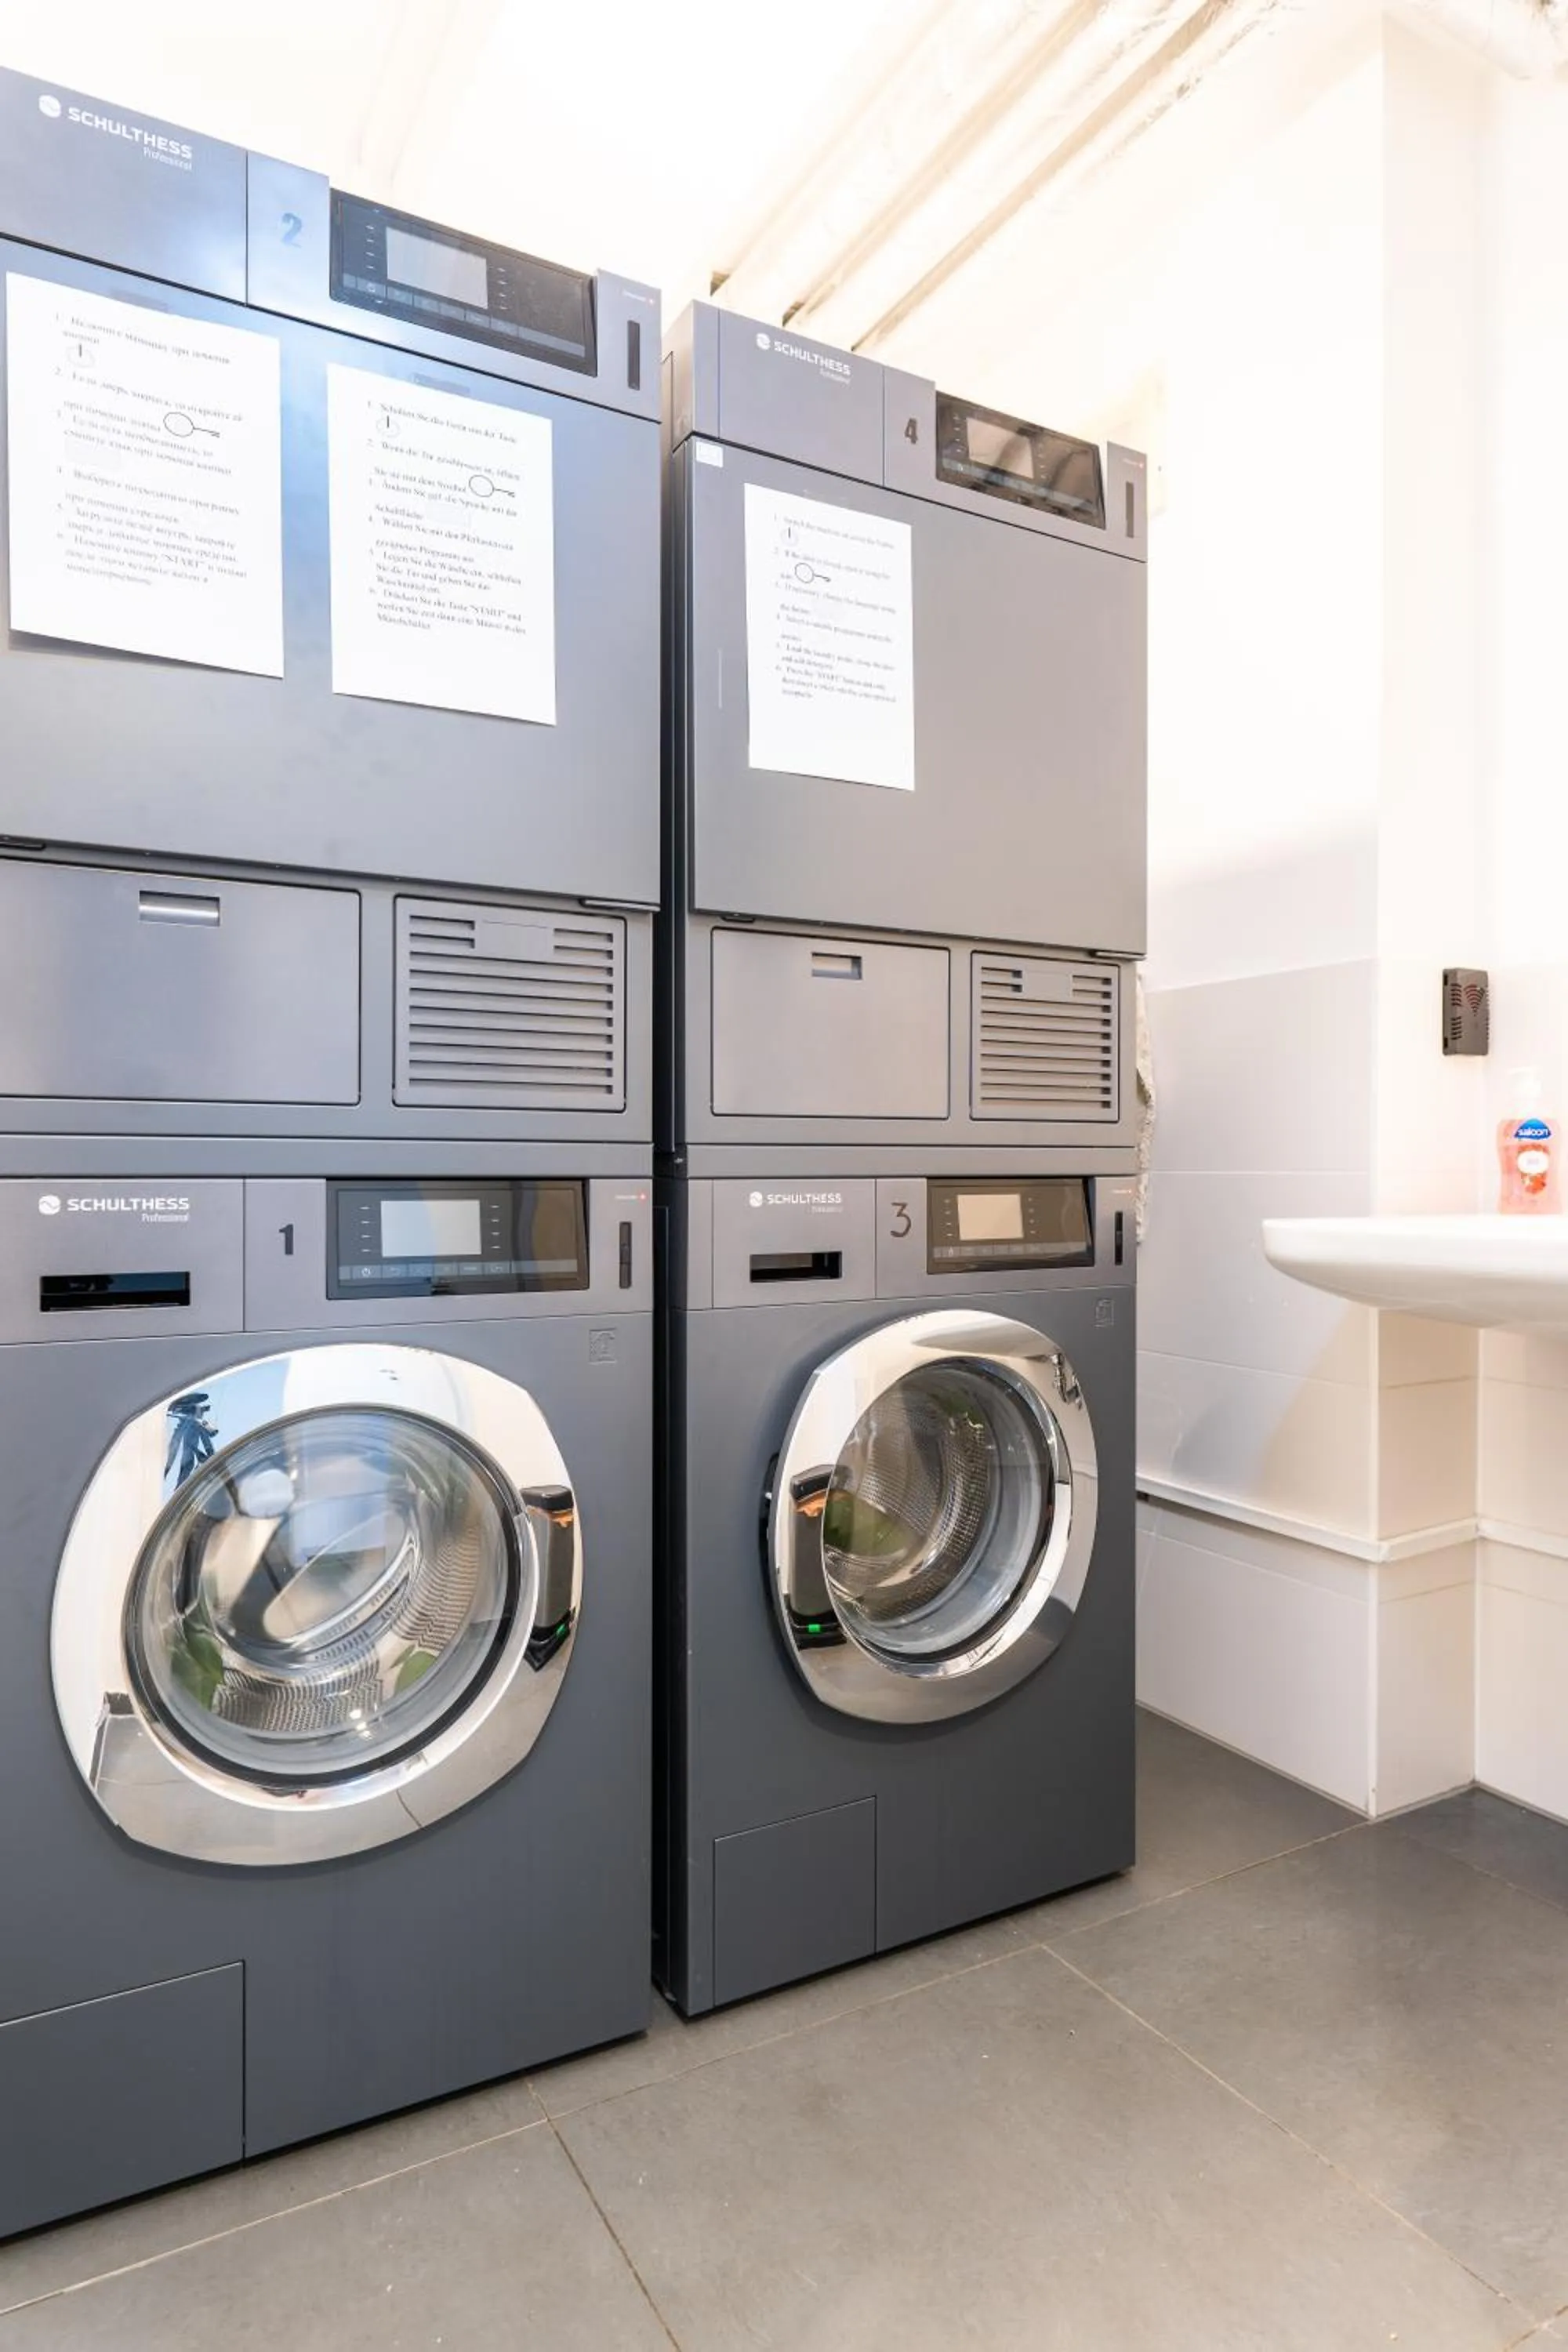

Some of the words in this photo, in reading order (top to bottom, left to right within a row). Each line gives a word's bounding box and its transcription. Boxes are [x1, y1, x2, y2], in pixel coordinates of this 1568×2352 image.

[68, 107, 193, 159] SCHULTHESS
[281, 212, 303, 248] 2
[774, 341, 851, 376] SCHULTHESS
[905, 418, 918, 445] 4
[67, 1197, 190, 1211] SCHULTHESS
[767, 1193, 841, 1205] SCHULTHESS
[890, 1202, 912, 1238] 3
[278, 1224, 294, 1255] 1
